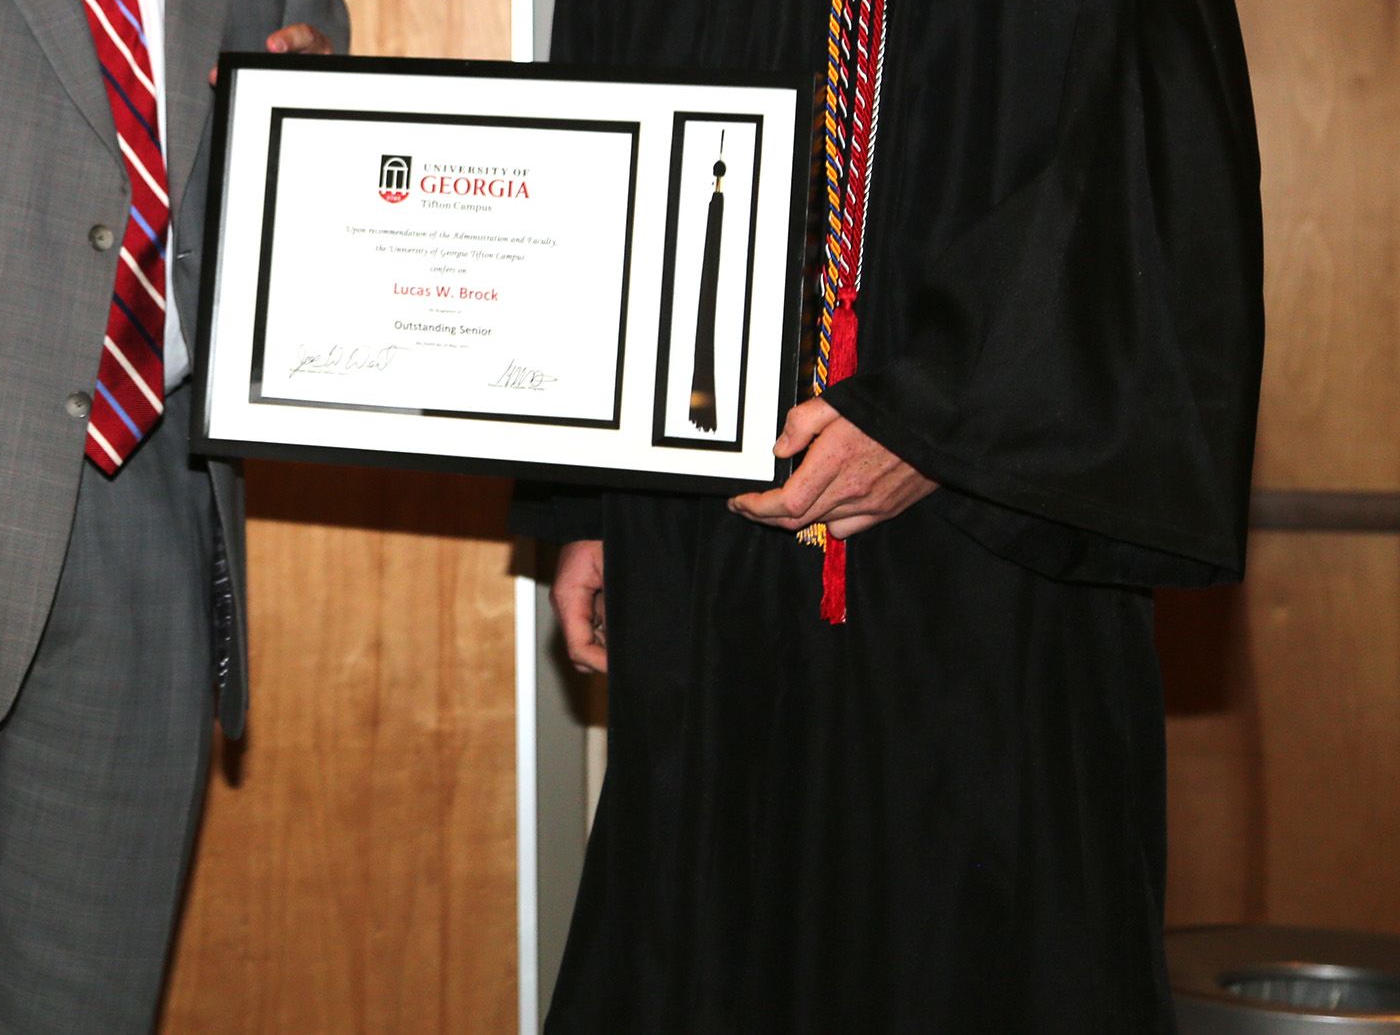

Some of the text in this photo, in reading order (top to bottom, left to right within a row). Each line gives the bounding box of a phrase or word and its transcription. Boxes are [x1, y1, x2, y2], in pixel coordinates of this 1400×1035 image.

[424, 163, 530, 177] UNIVERSITY OF
[420, 175, 530, 199] GEORGIA
[421, 199, 492, 212] Tifton Campus
[439, 231, 450, 239] the
[510, 236, 525, 244] and
[393, 282, 498, 301] Lucas W. Brock
[394, 320, 492, 336] Outstanding Senior
